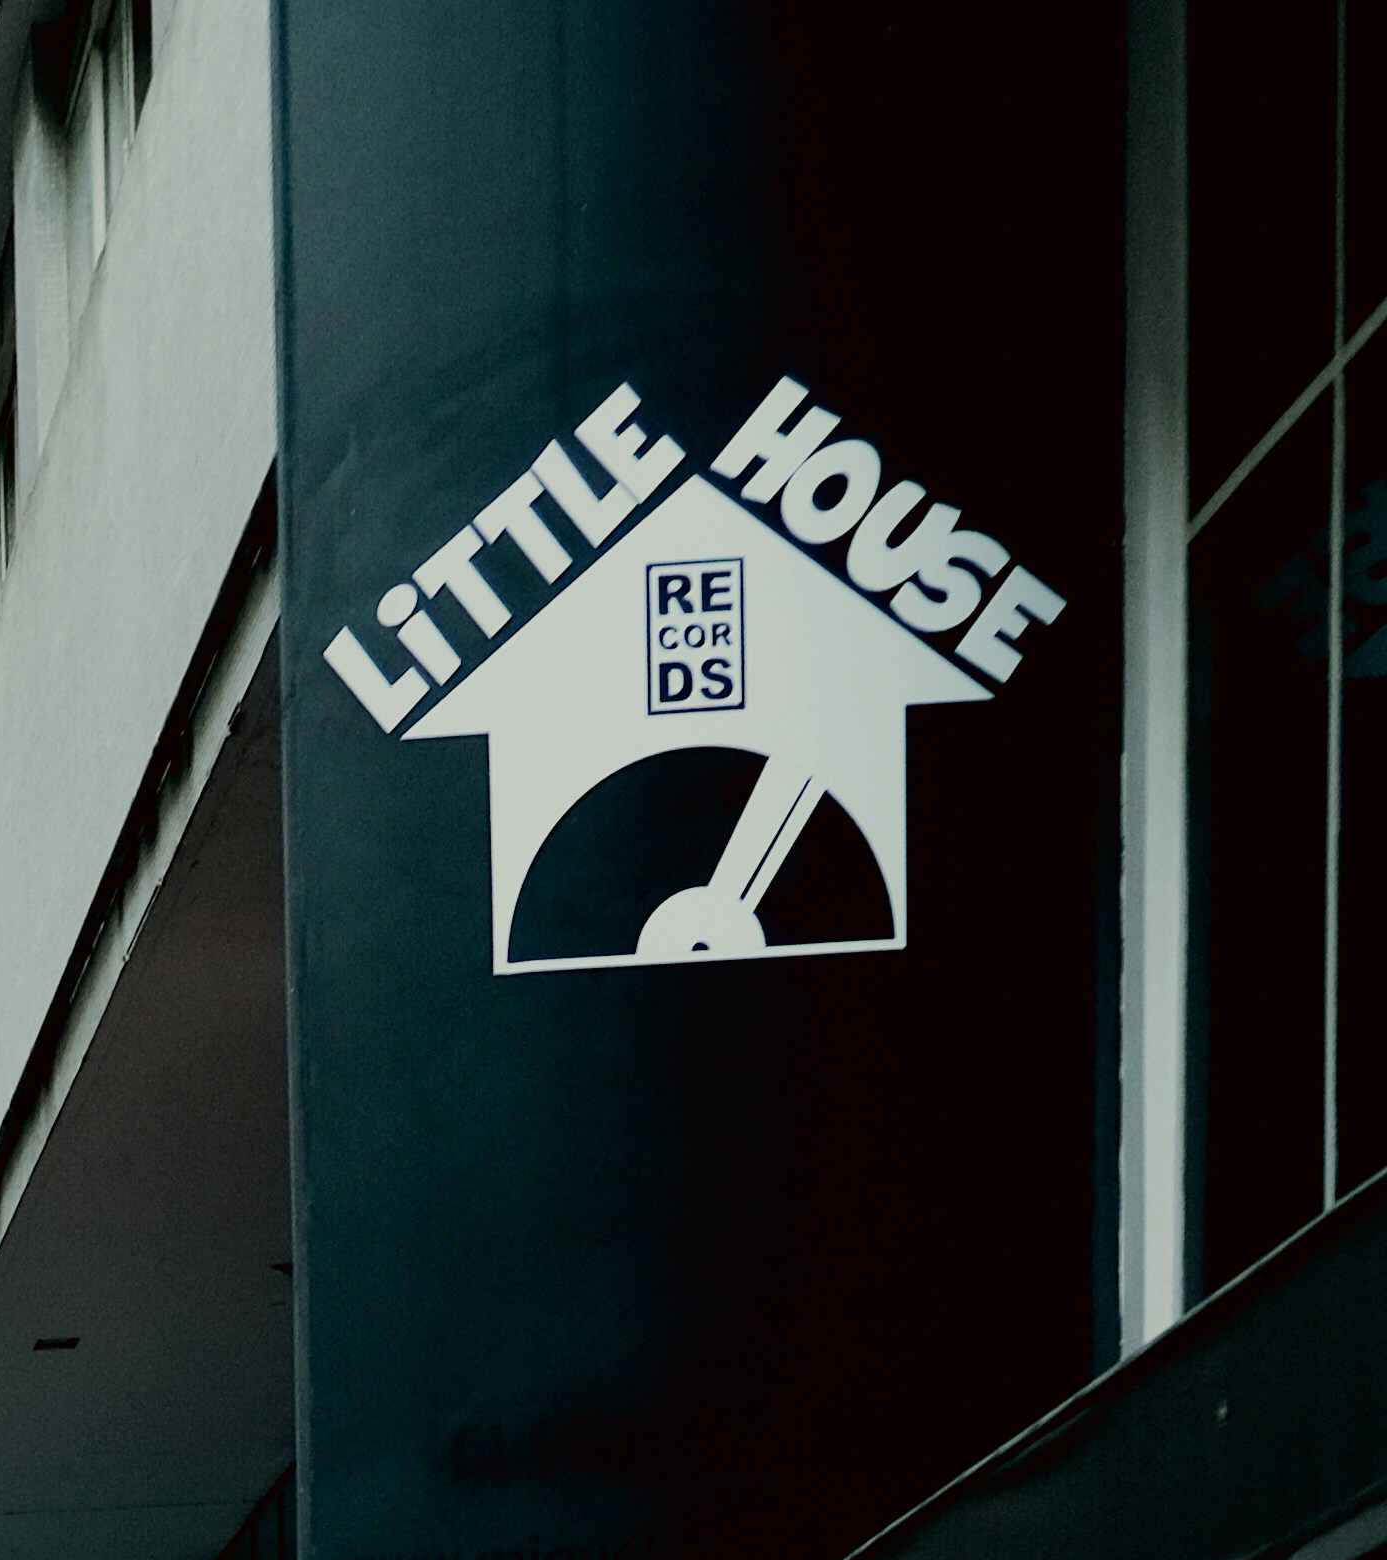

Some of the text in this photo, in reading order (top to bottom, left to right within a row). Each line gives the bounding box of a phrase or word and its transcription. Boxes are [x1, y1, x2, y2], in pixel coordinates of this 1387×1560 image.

[710, 375, 1068, 684] HOUSE
[657, 571, 735, 615] RE
[658, 623, 734, 652] COR
[658, 657, 736, 704] DS
